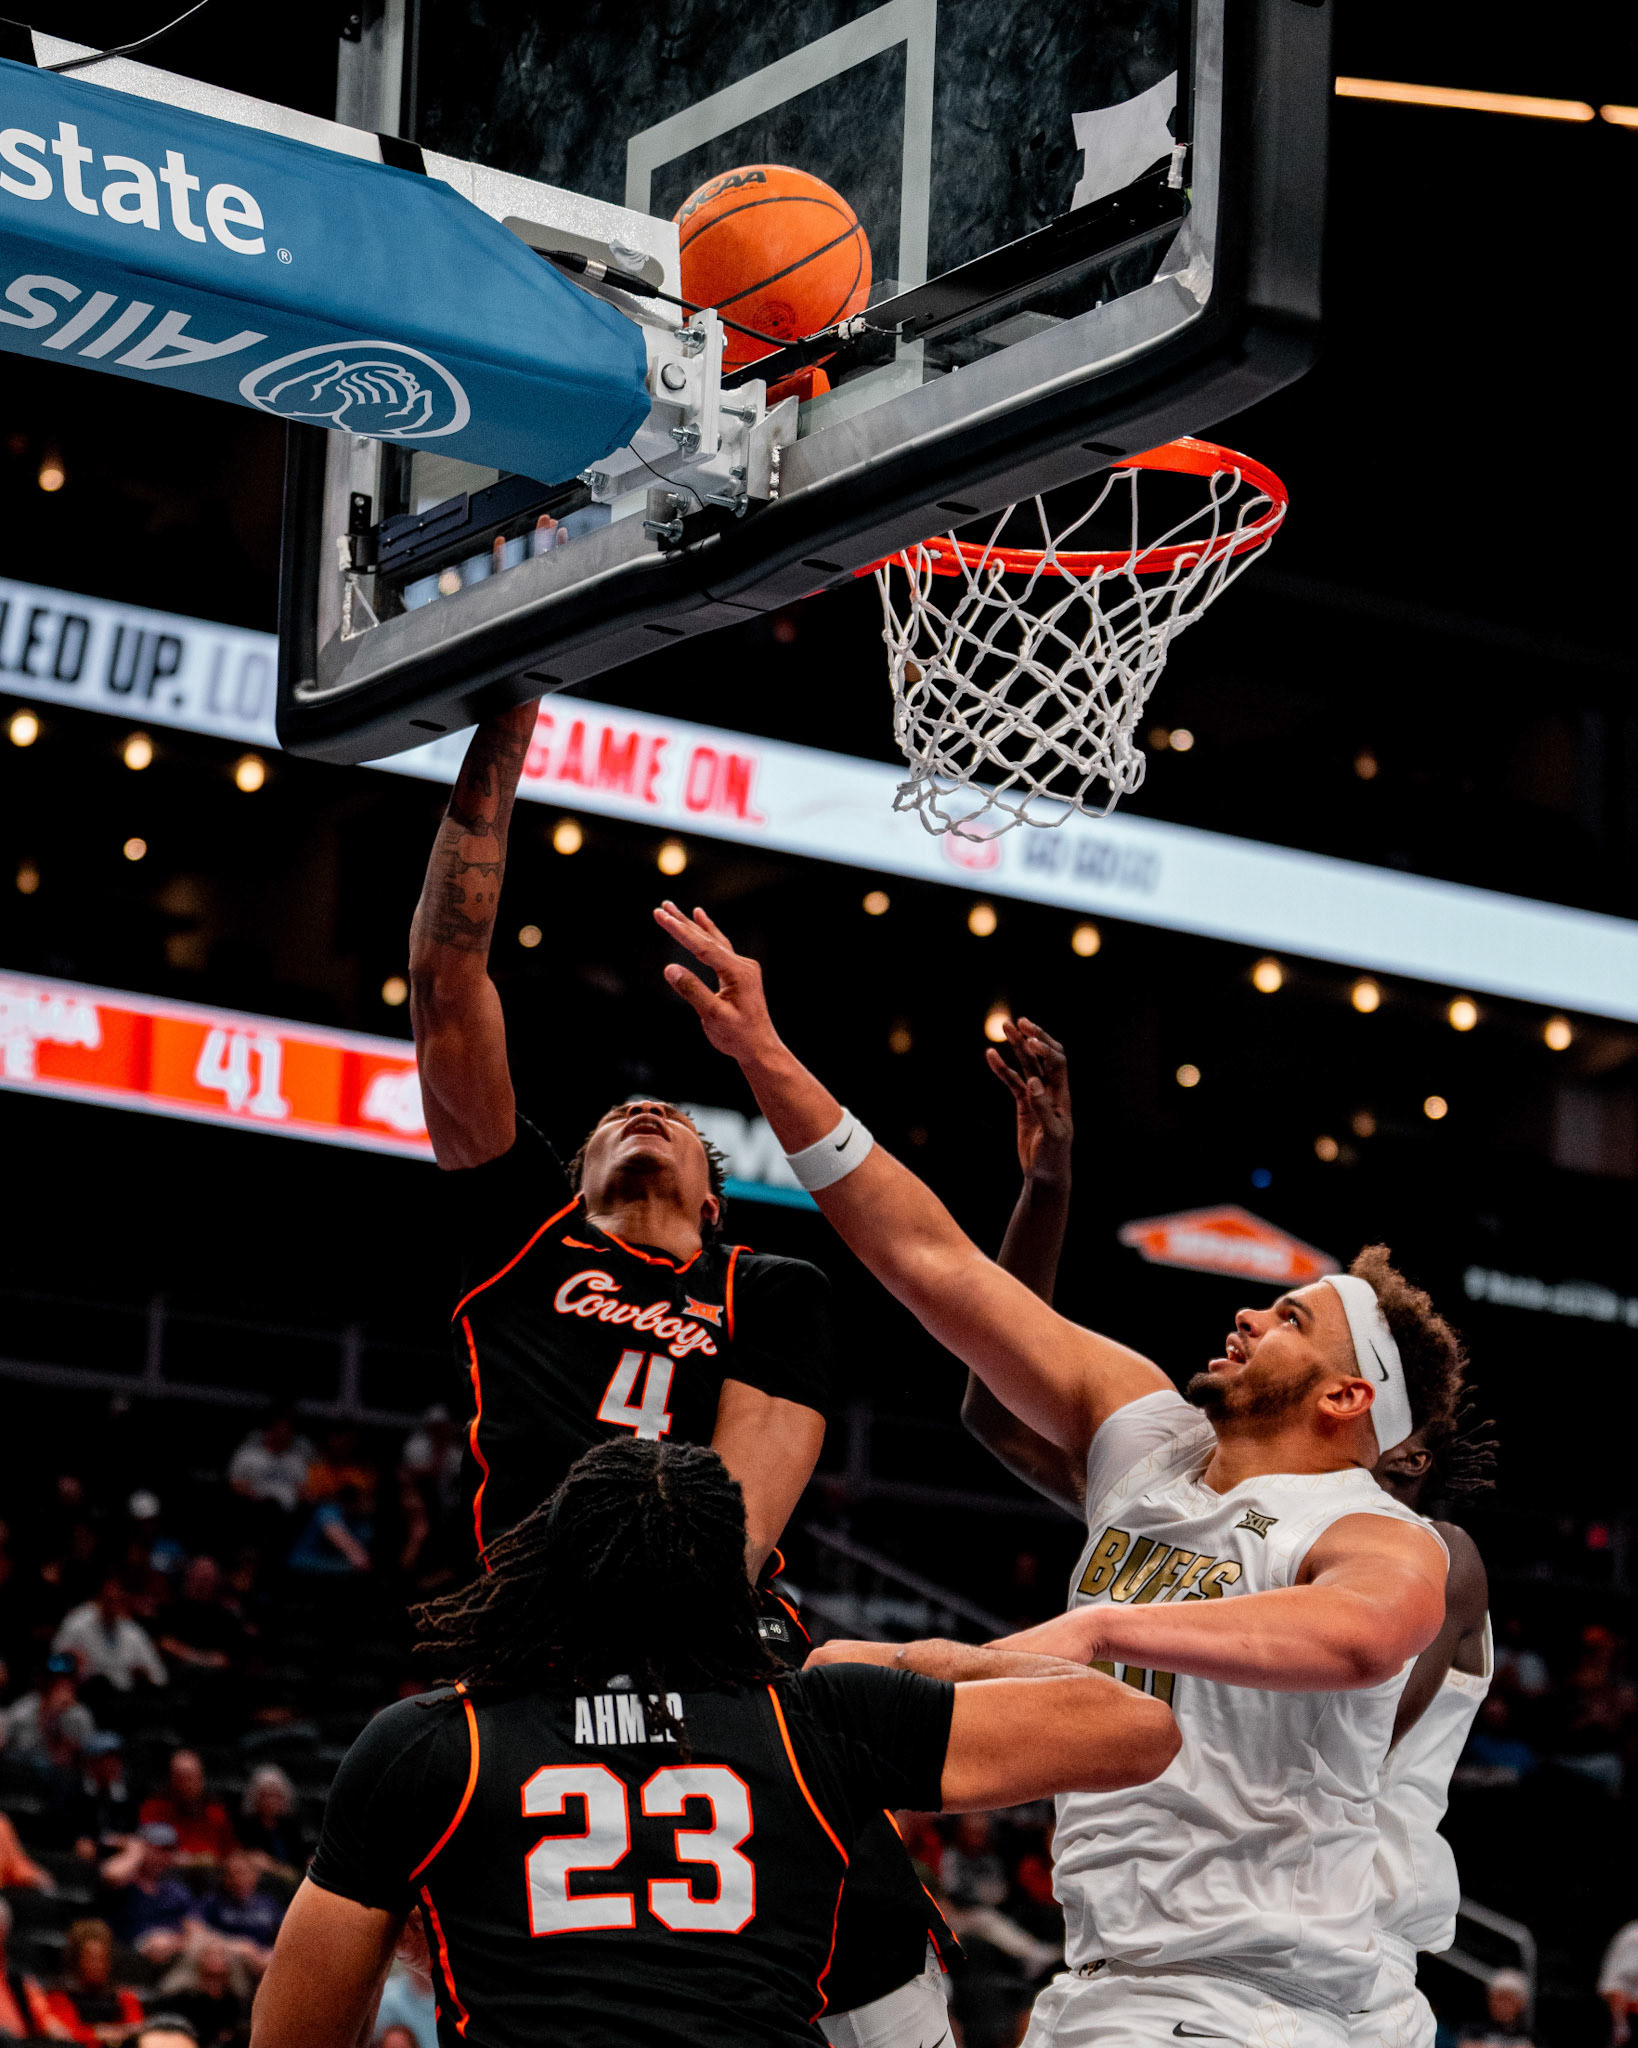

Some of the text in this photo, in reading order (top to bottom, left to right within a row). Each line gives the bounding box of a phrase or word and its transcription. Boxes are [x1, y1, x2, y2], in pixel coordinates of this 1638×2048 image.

[0, 121, 266, 256] state
[680, 171, 767, 227] NCAA
[108, 623, 183, 706] UP.
[523, 713, 669, 804] GAME
[197, 1028, 290, 1118] 41
[596, 1349, 676, 1441] 4
[1077, 1527, 1242, 1605] BUFFS
[521, 1763, 756, 1938] 23
